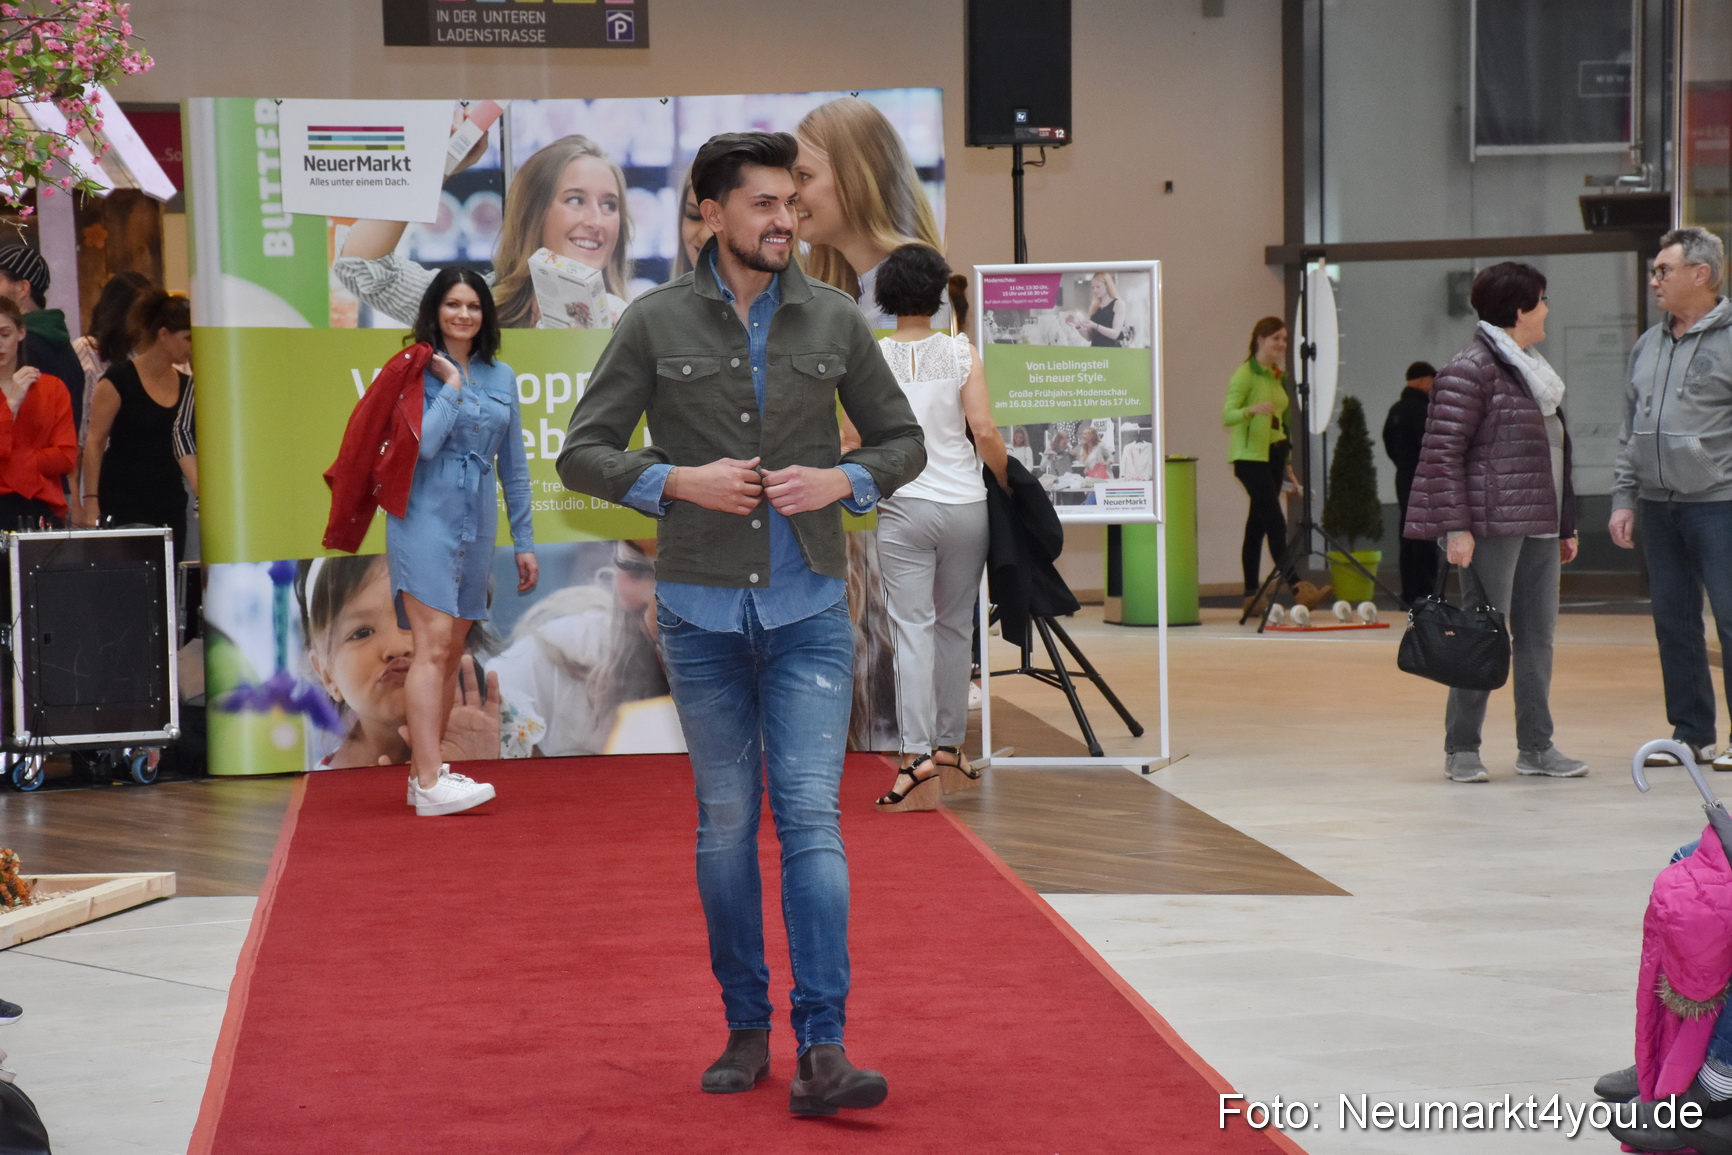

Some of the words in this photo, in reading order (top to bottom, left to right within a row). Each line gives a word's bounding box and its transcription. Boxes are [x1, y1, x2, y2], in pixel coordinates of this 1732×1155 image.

[436, 9, 450, 23] IN
[453, 10, 477, 23] DER
[482, 11, 546, 24] UNTEREN
[437, 28, 546, 43] LADENSTRASSE
[614, 20, 628, 40] P
[1054, 129, 1065, 138] 12
[303, 155, 412, 172] NeuerMarkt
[309, 177, 330, 186] Alles
[331, 178, 354, 187] unter
[356, 177, 383, 187] einem
[384, 177, 410, 187] Dach.
[1025, 361, 1045, 371] Von
[1047, 360, 1109, 372] Lieblingsteil
[1029, 374, 1044, 383] bis
[1046, 374, 1075, 383] neuer
[1077, 372, 1106, 384] Style.
[1008, 389, 1033, 398] Große
[1034, 388, 1128, 398] Frühjahrs-Modenschau
[1008, 399, 1055, 408] 16.03.2019
[1073, 399, 1082, 407] 11
[1083, 398, 1098, 407] Uhr
[1099, 398, 1111, 406] bis
[1113, 398, 1123, 406] 17
[1124, 397, 1142, 406] Uhr.
[1103, 498, 1147, 506] NeuerMarkt
